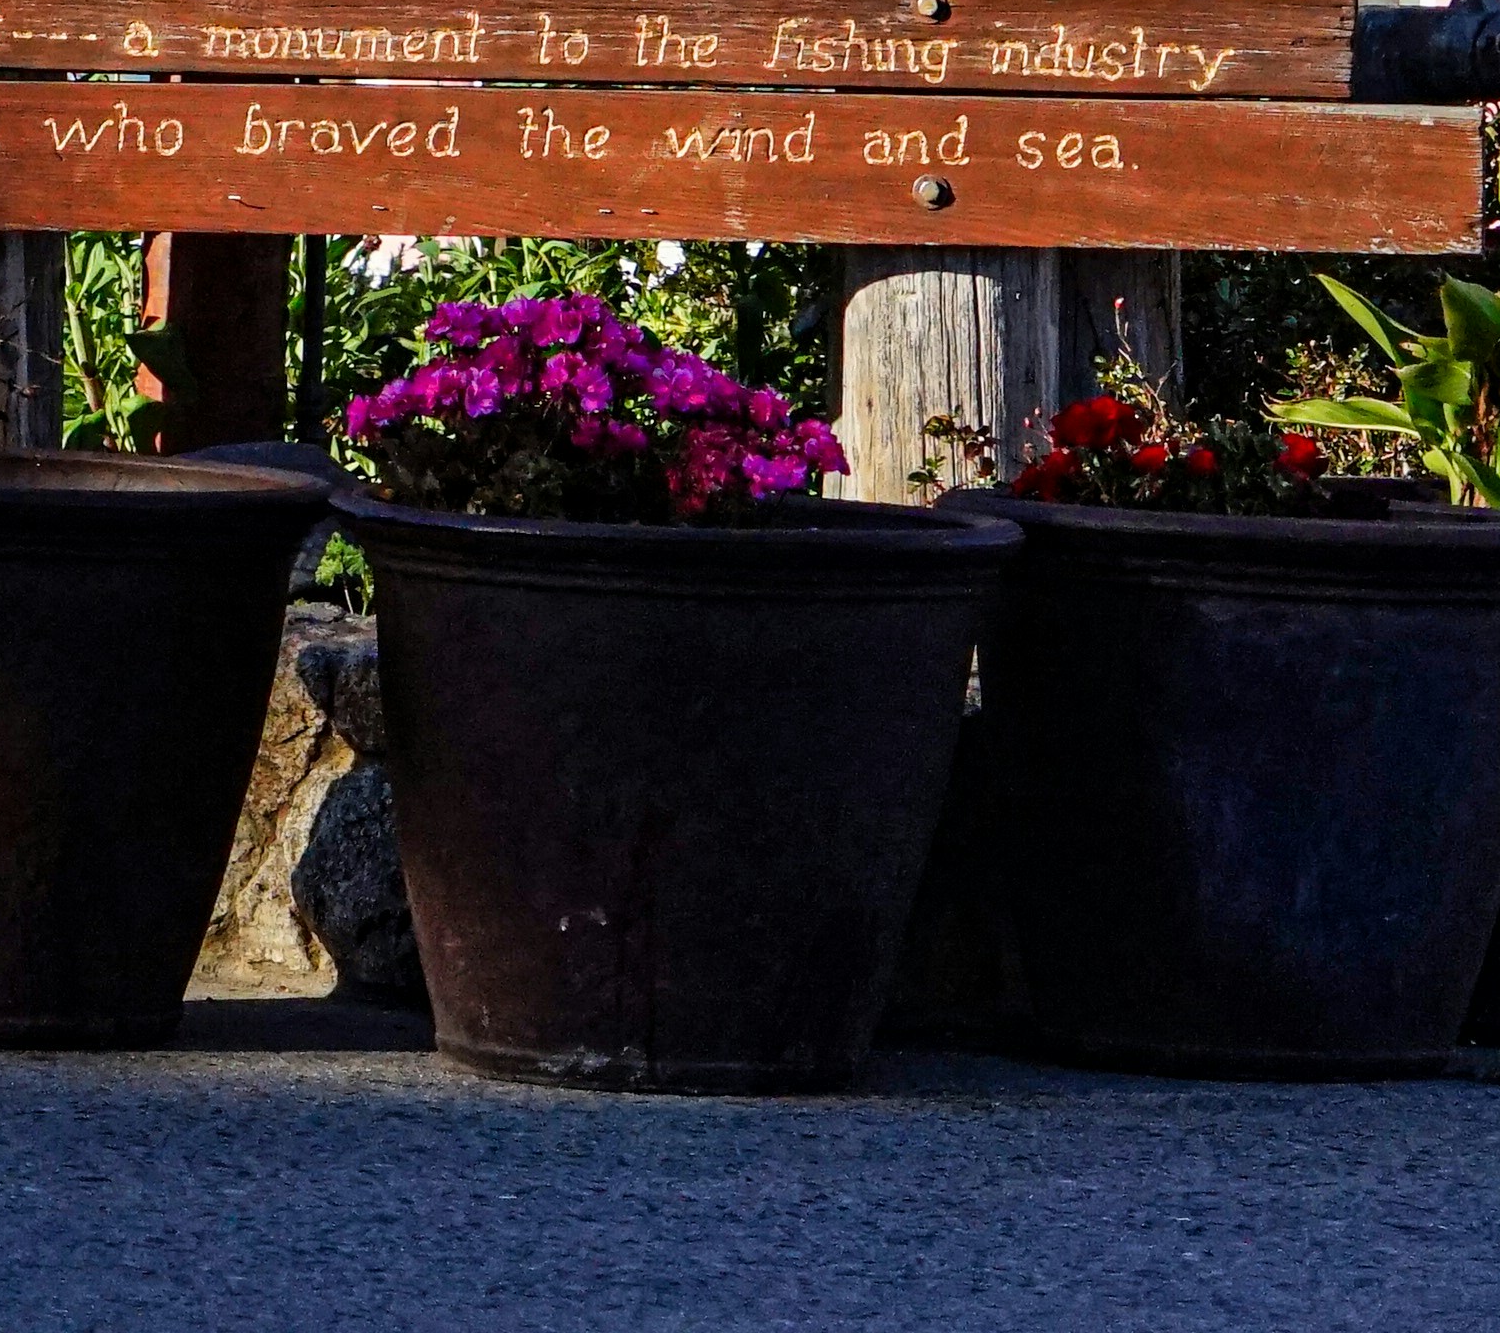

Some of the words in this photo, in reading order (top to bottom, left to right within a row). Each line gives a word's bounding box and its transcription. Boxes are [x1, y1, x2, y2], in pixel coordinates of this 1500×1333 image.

[122, 19, 160, 58] a
[201, 9, 486, 64] monument
[536, 12, 590, 65] to
[636, 14, 719, 69] the
[764, 17, 958, 84] fishing
[988, 22, 1235, 91] industry
[43, 100, 184, 156] who
[235, 101, 461, 158] braved
[517, 106, 612, 160] the
[665, 110, 816, 164] wind
[862, 114, 970, 166] and
[1015, 130, 1140, 170] sea.
